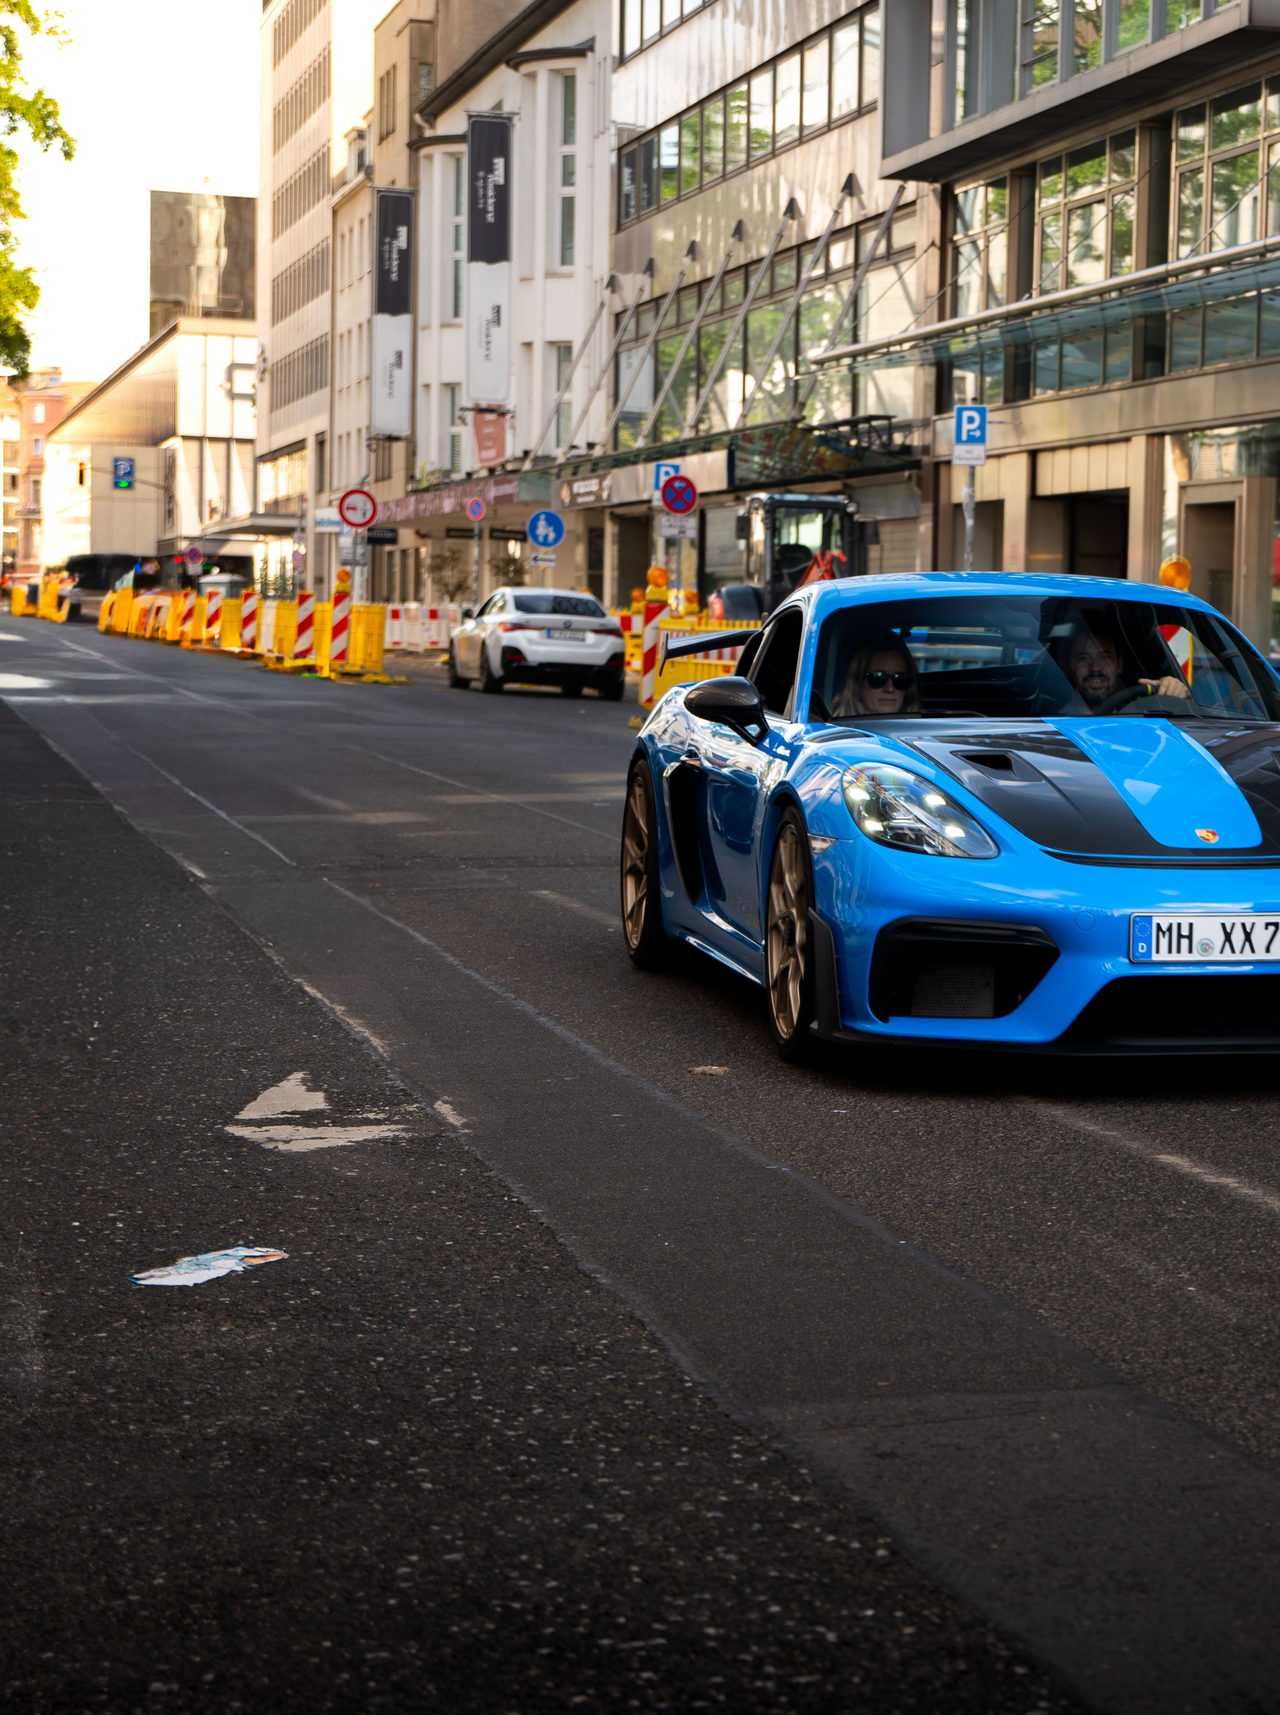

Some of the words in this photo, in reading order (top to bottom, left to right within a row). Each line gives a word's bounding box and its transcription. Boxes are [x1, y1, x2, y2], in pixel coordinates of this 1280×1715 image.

[961, 410, 981, 441] P
[1138, 942, 1148, 953] D
[1155, 922, 1194, 955] MH
